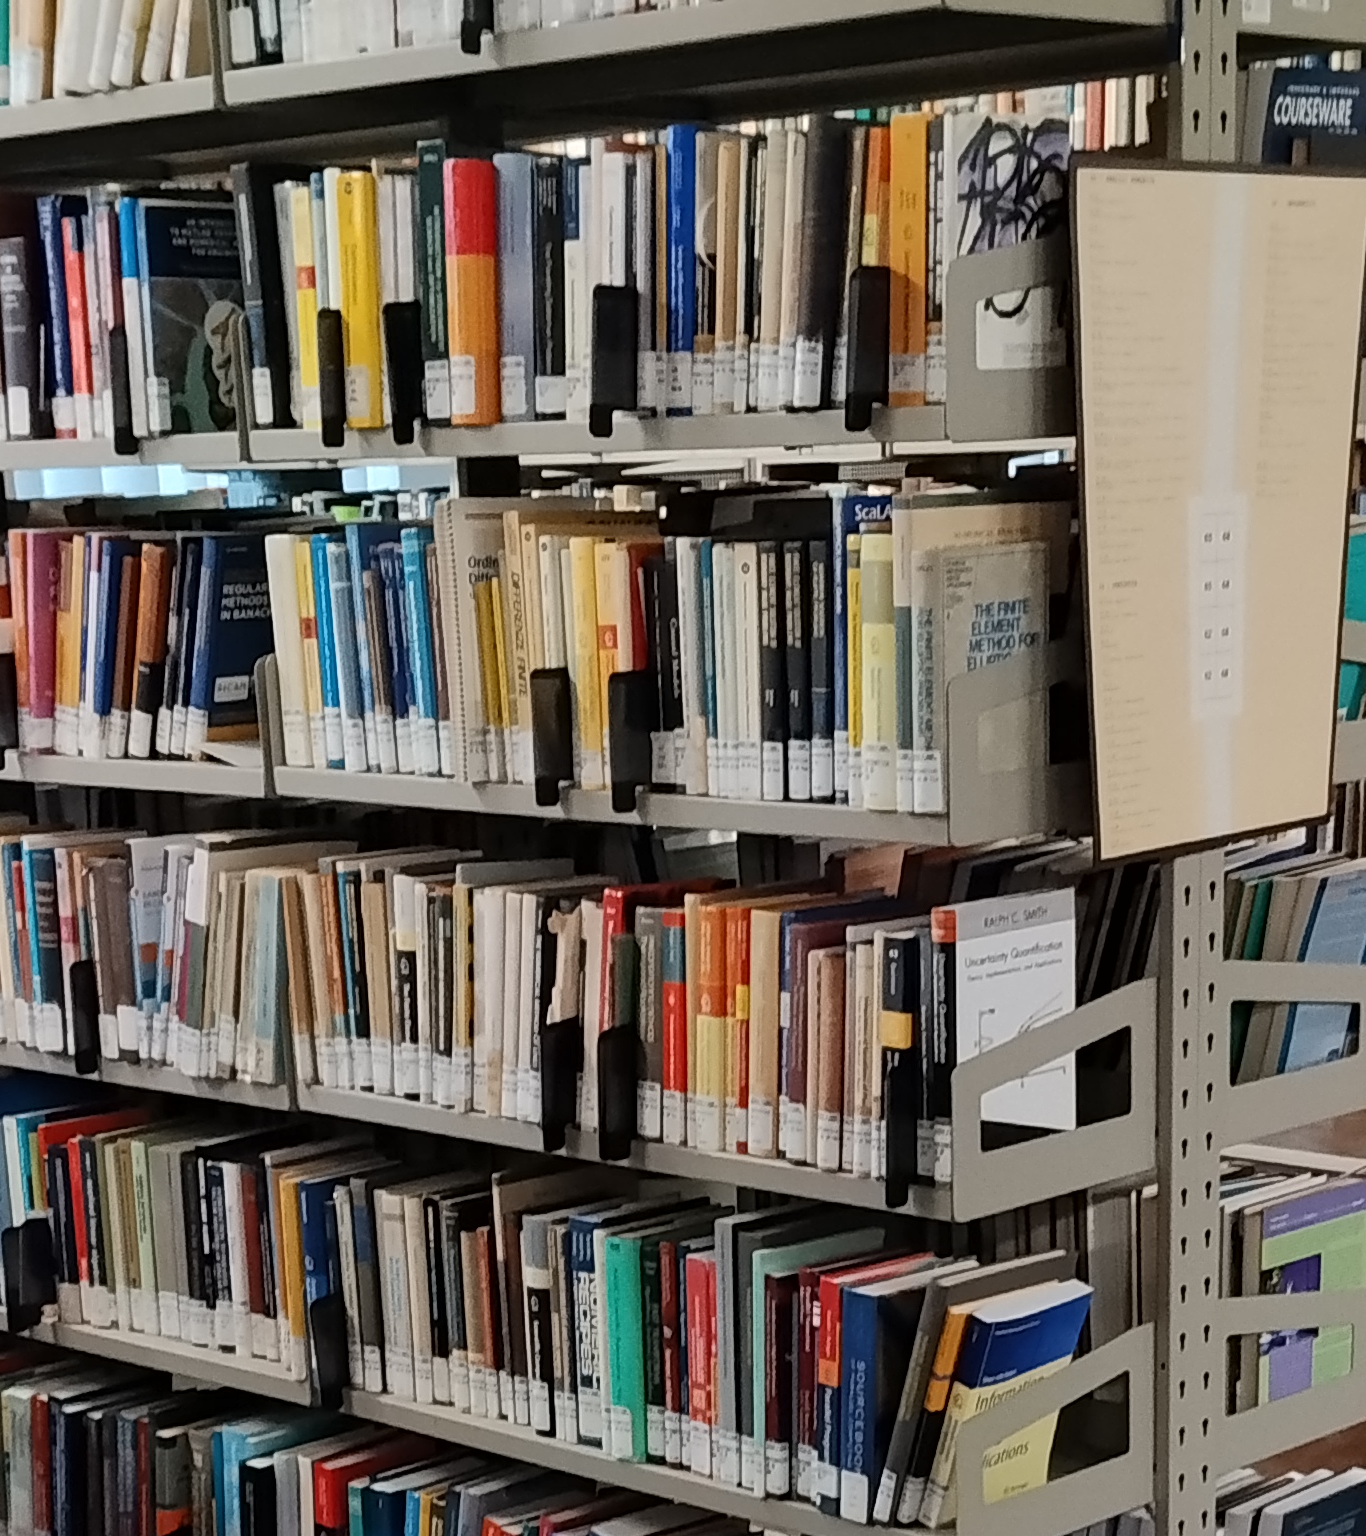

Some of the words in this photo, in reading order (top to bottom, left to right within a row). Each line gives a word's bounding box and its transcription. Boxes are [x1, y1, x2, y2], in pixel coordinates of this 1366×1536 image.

[1273, 94, 1353, 127] COURSEWARE
[974, 602, 996, 618] THE
[997, 599, 1031, 616] FINITE
[971, 617, 1021, 636] ELEMENT
[968, 636, 1016, 654] METHOD
[1017, 632, 1039, 648] FOR
[983, 915, 1010, 929] RALPH
[1022, 906, 1049, 921] SMITH
[964, 951, 1009, 969] Uncertainty
[1010, 940, 1064, 959] Quantification
[578, 1271, 592, 1377] RECIPES
